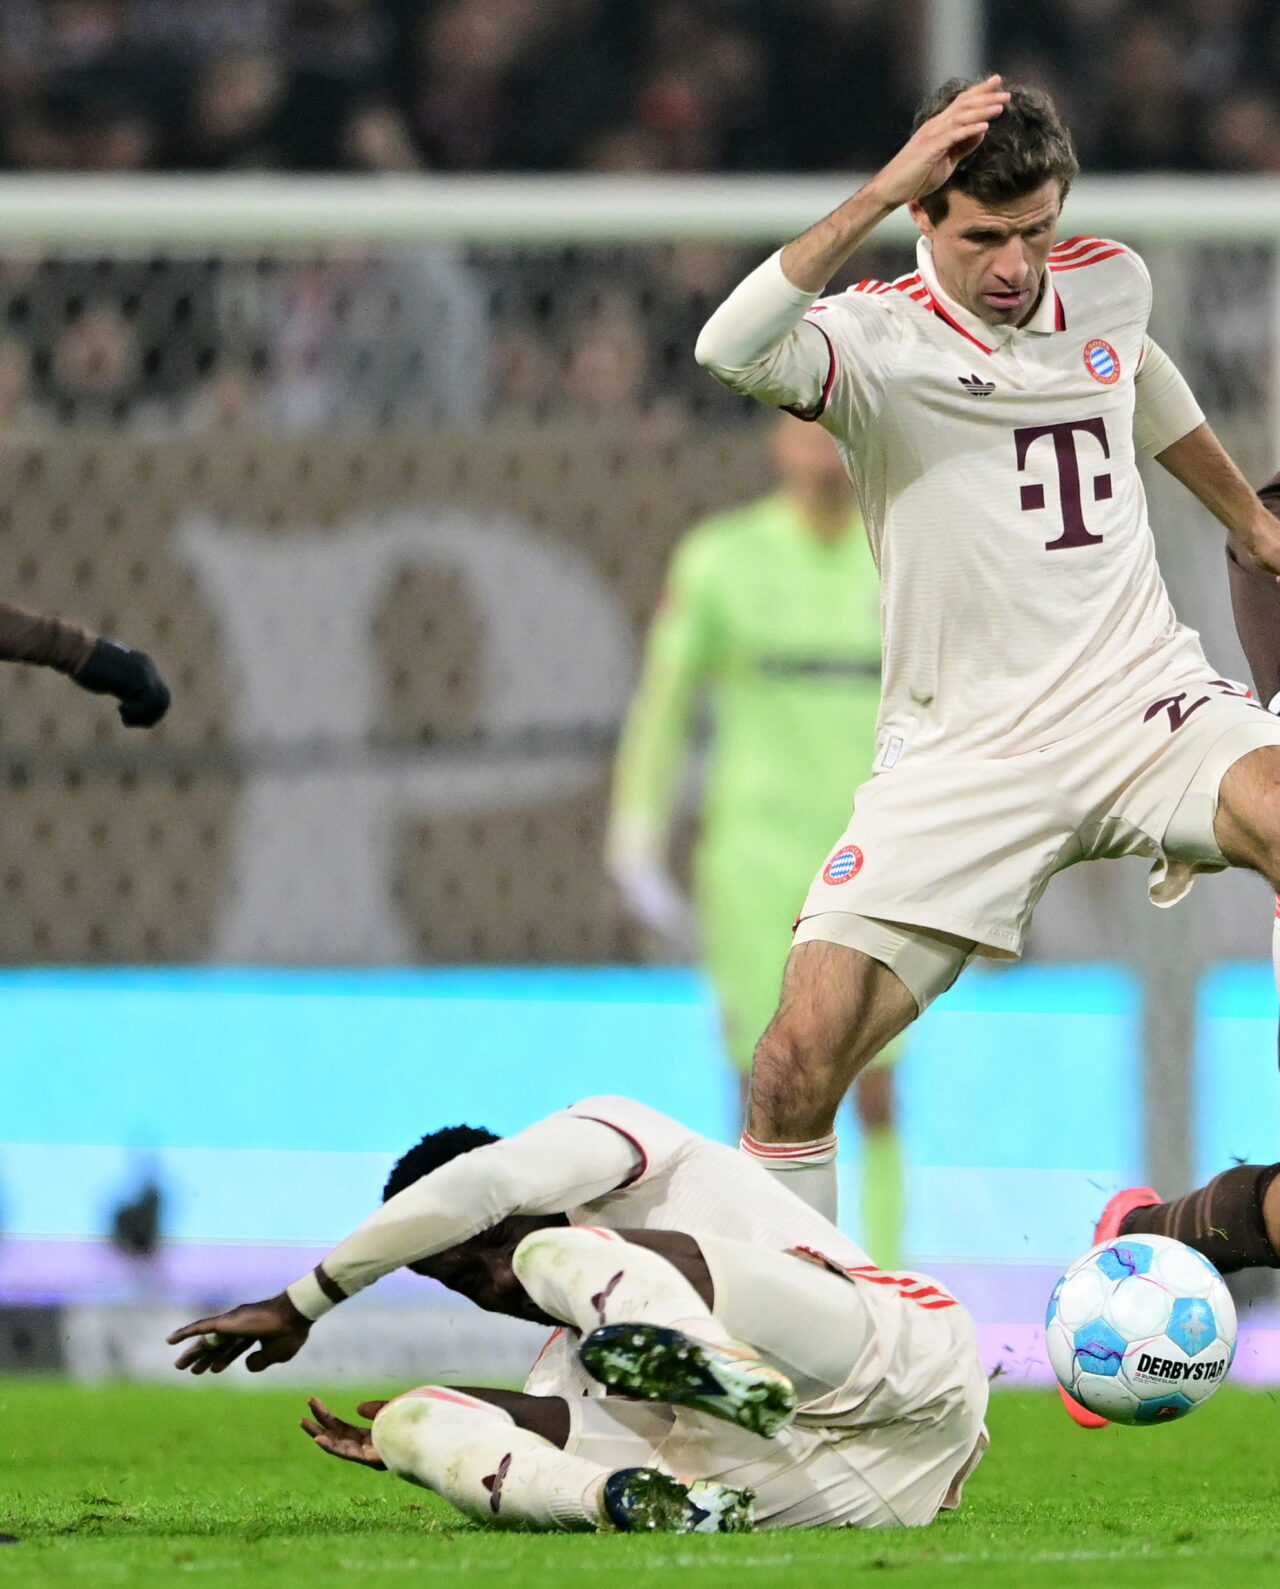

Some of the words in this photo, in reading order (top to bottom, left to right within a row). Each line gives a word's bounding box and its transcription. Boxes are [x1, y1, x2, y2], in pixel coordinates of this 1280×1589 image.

[1013, 417, 1112, 551] T
[1136, 1352, 1226, 1381] DERBYSTAR
[1141, 1373, 1178, 1385] BUNDESLIGA
